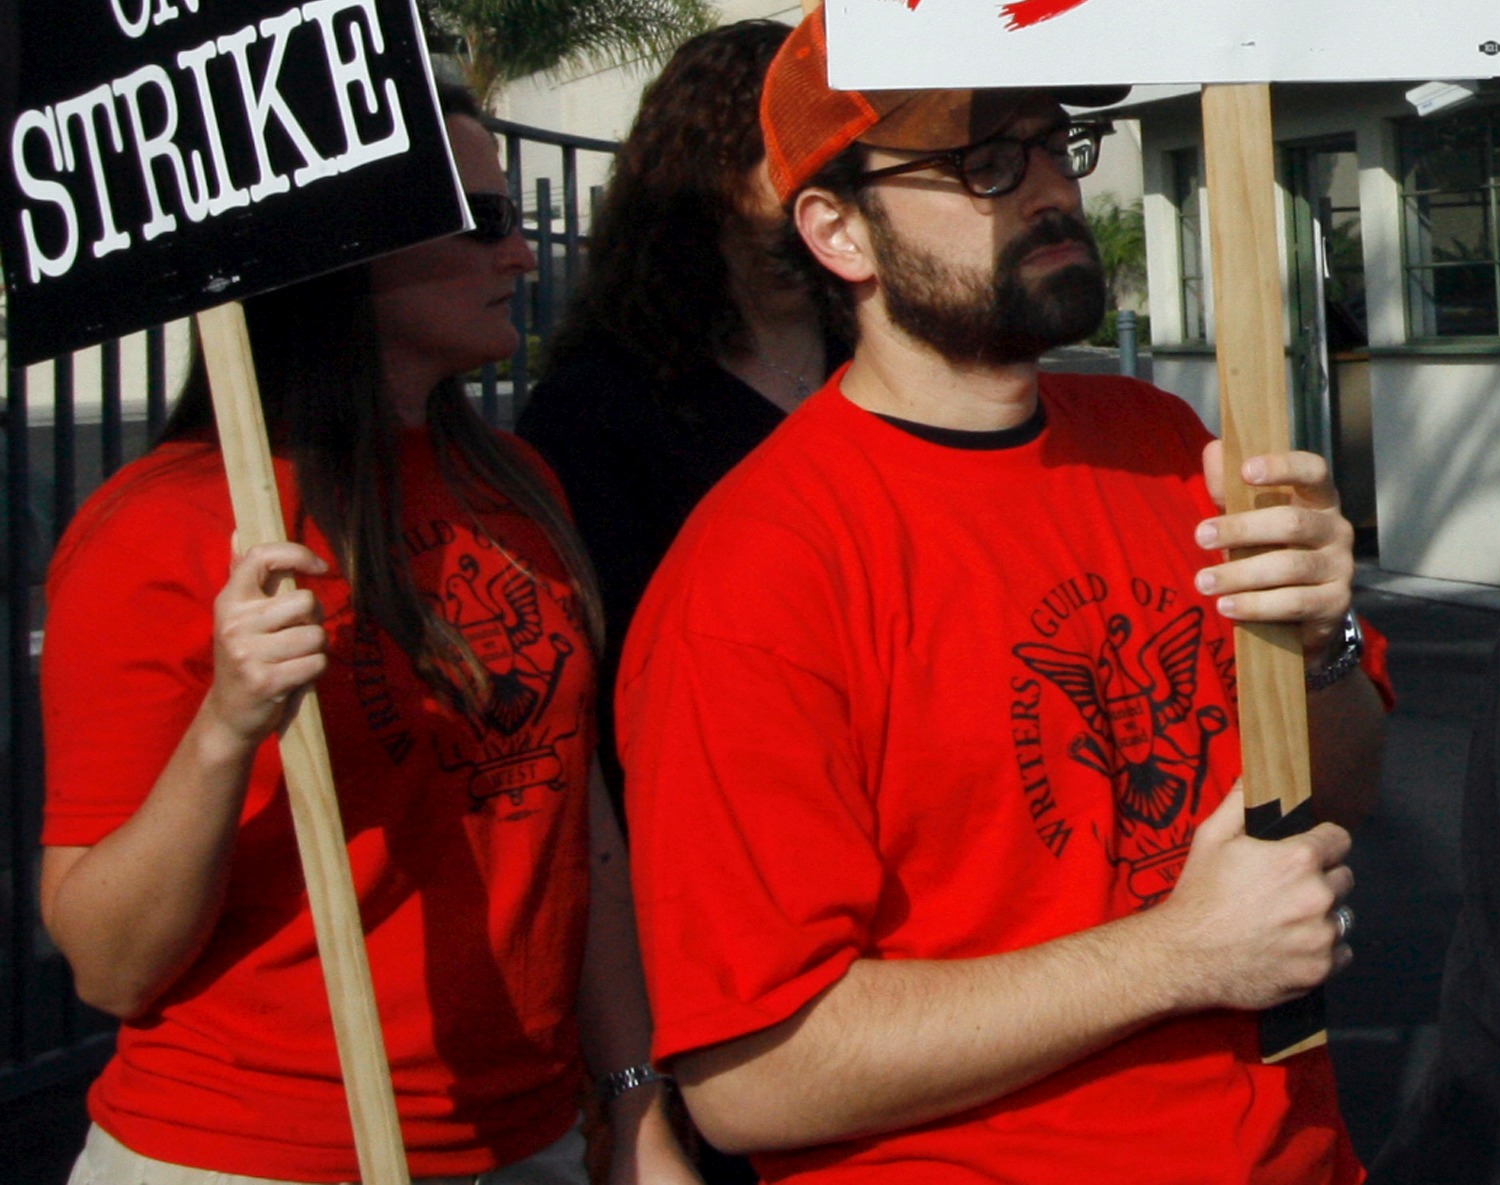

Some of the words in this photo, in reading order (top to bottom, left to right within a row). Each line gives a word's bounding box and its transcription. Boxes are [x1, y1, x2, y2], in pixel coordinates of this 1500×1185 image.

[1030, 573, 1109, 638] GUILD
[1130, 576, 1178, 613] OF
[1010, 676, 1074, 860] WRITERS
